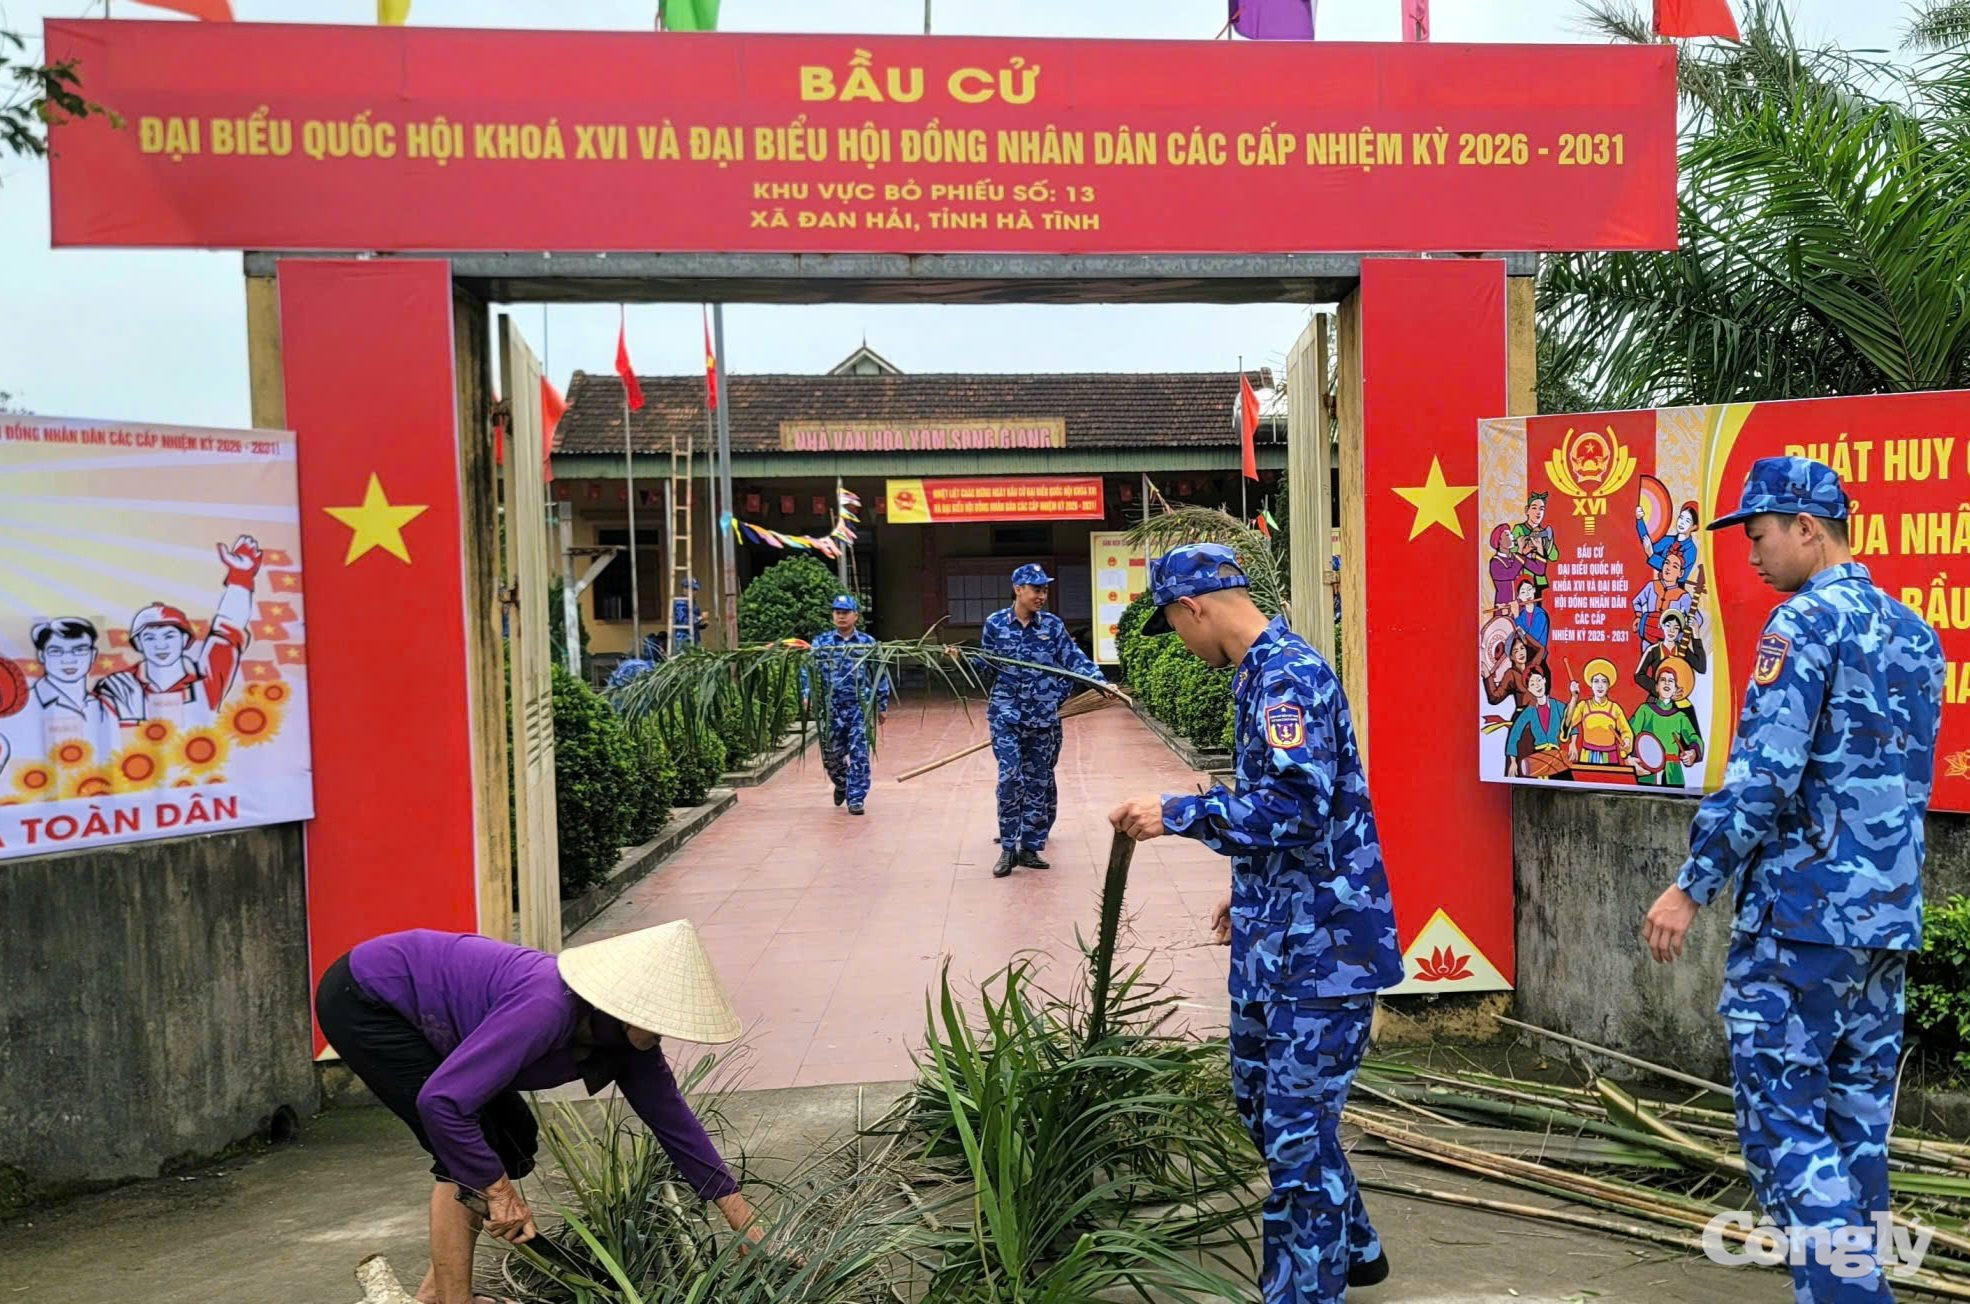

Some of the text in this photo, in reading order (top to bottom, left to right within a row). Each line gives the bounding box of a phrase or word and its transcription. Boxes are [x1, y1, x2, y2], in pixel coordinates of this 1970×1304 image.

[800, 48, 1040, 104] BẦU CỬ
[139, 117, 201, 161] ĐẠI
[211, 105, 292, 156] BIỂU
[303, 110, 396, 160] QUỐC
[406, 116, 464, 166] HỘI
[474, 118, 565, 160] KHOÁ
[575, 125, 628, 160] XVI
[637, 119, 680, 160] VÀ
[690, 126, 744, 168] ĐẠI
[755, 114, 827, 161] BIỂU
[838, 121, 891, 169] HỘI
[901, 118, 987, 163] ĐỒNG
[998, 124, 1084, 165] NHÂN
[1095, 125, 1157, 165] DÂN
[1167, 125, 1227, 165] CÁC
[1237, 121, 1296, 165] CẤP
[1306, 126, 1403, 172] NHIỆM
[1413, 126, 1449, 165] KỲ
[1459, 133, 1529, 165] 2026
[1558, 133, 1625, 165] 2031
[753, 178, 1095, 204] KHU VỰC BỎ PHIẾU SỐ: 13
[751, 207, 1099, 232] XÃ ĐAN HẢI, TỈNH HÀ TĨNH
[1885, 437, 1955, 481] HUY
[1573, 498, 1607, 515] XVI
[1849, 500, 1889, 556] ỦA
[21, 804, 141, 844] TOÀN
[156, 793, 238, 828] DÂN
